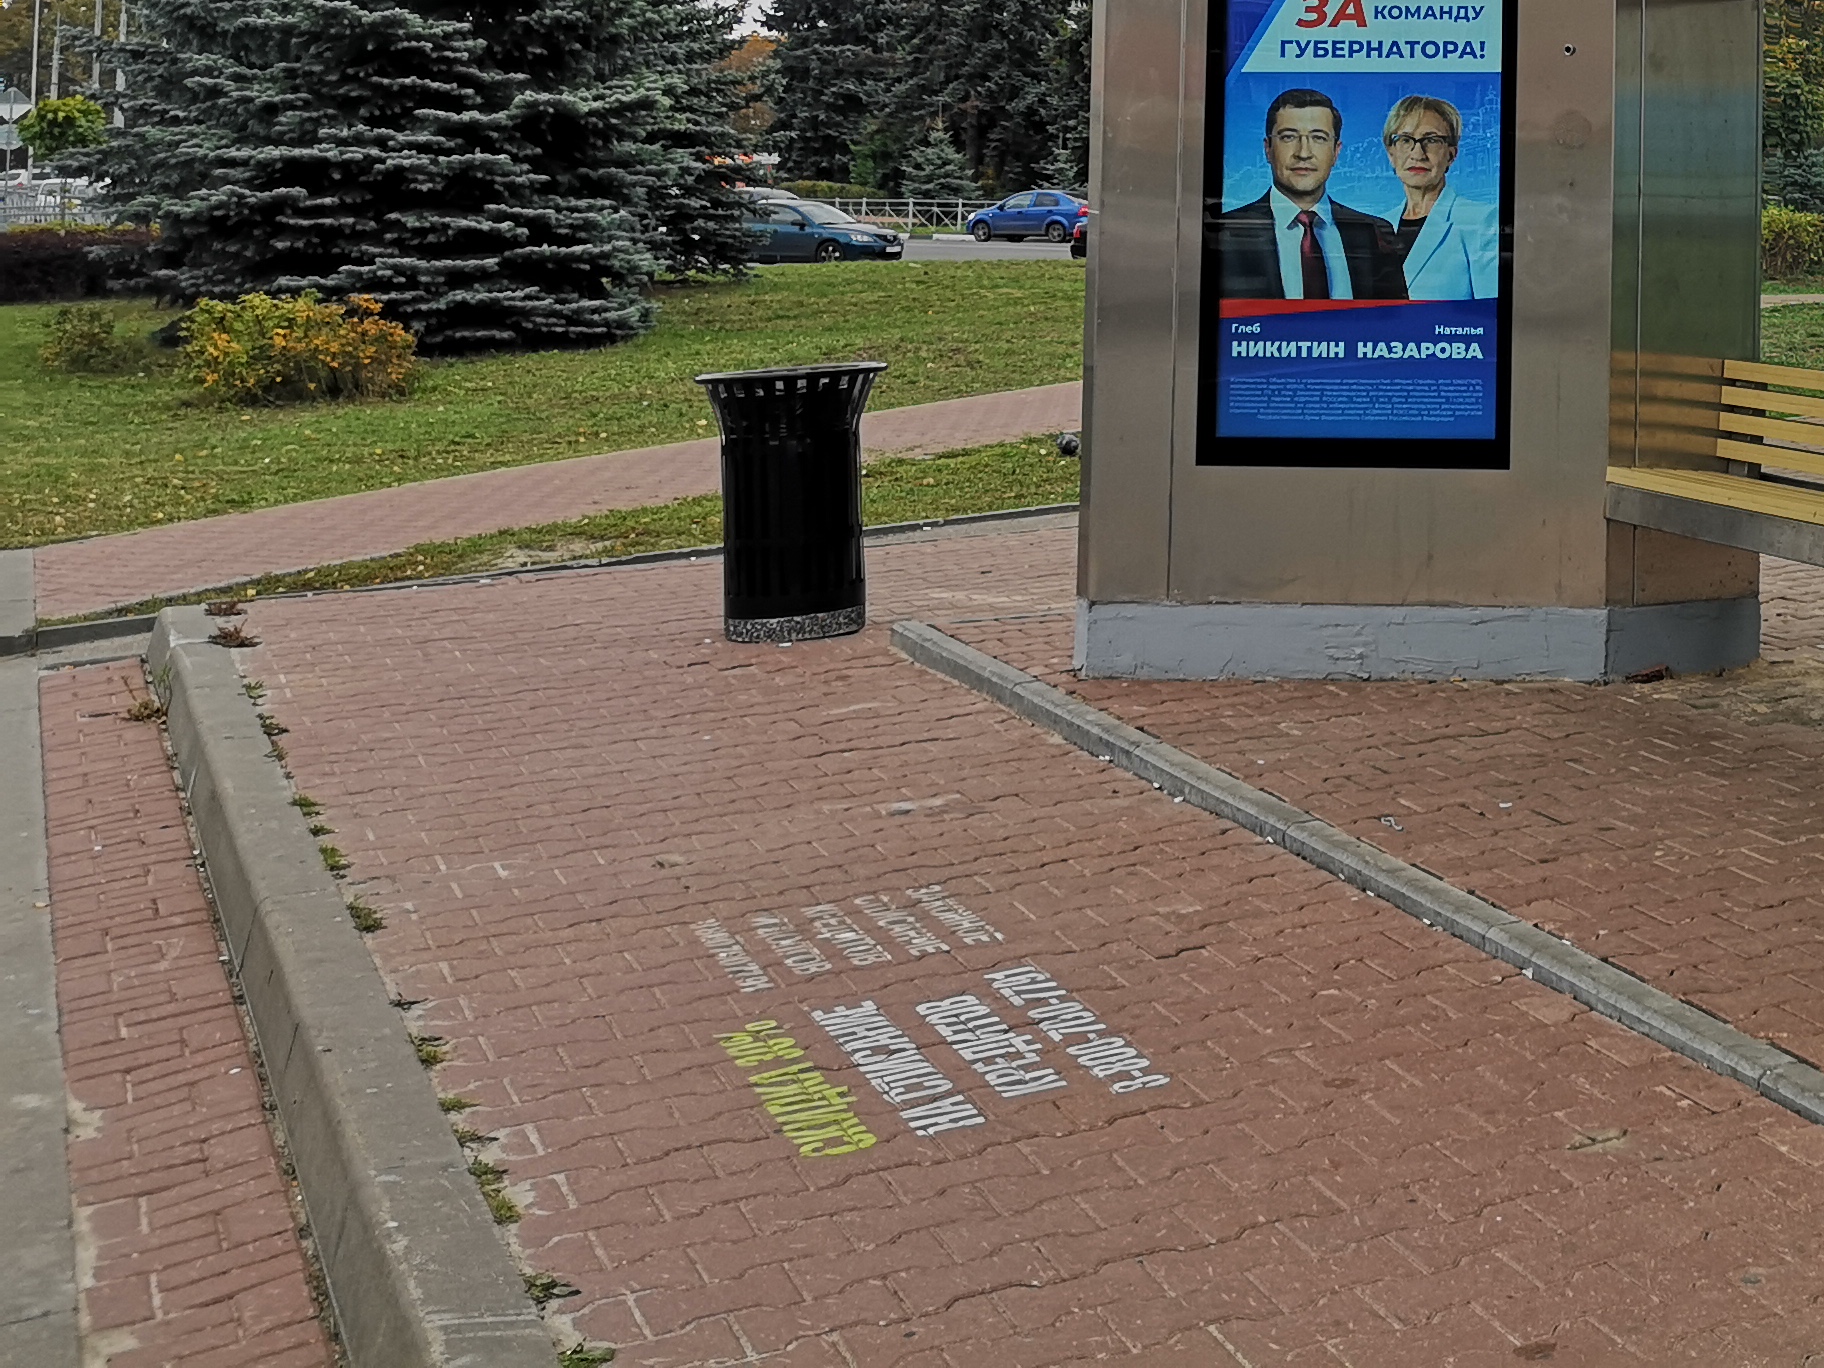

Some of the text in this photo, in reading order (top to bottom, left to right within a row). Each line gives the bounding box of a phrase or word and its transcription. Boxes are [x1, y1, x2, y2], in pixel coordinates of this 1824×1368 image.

[1374, 5, 1485, 23] КОМАНДУ
[1279, 39, 1487, 61] ГУБЕРНАТОРА!
[1231, 323, 1484, 335] Глеб Наталья
[1231, 340, 1484, 359] НИКИТИН НАЗАРОВА
[915, 993, 1068, 1099] КРЕДИТОВ
[809, 999, 987, 1137] НА СПИСАНИЕ
[713, 1019, 878, 1157] СКИДКА 30%
